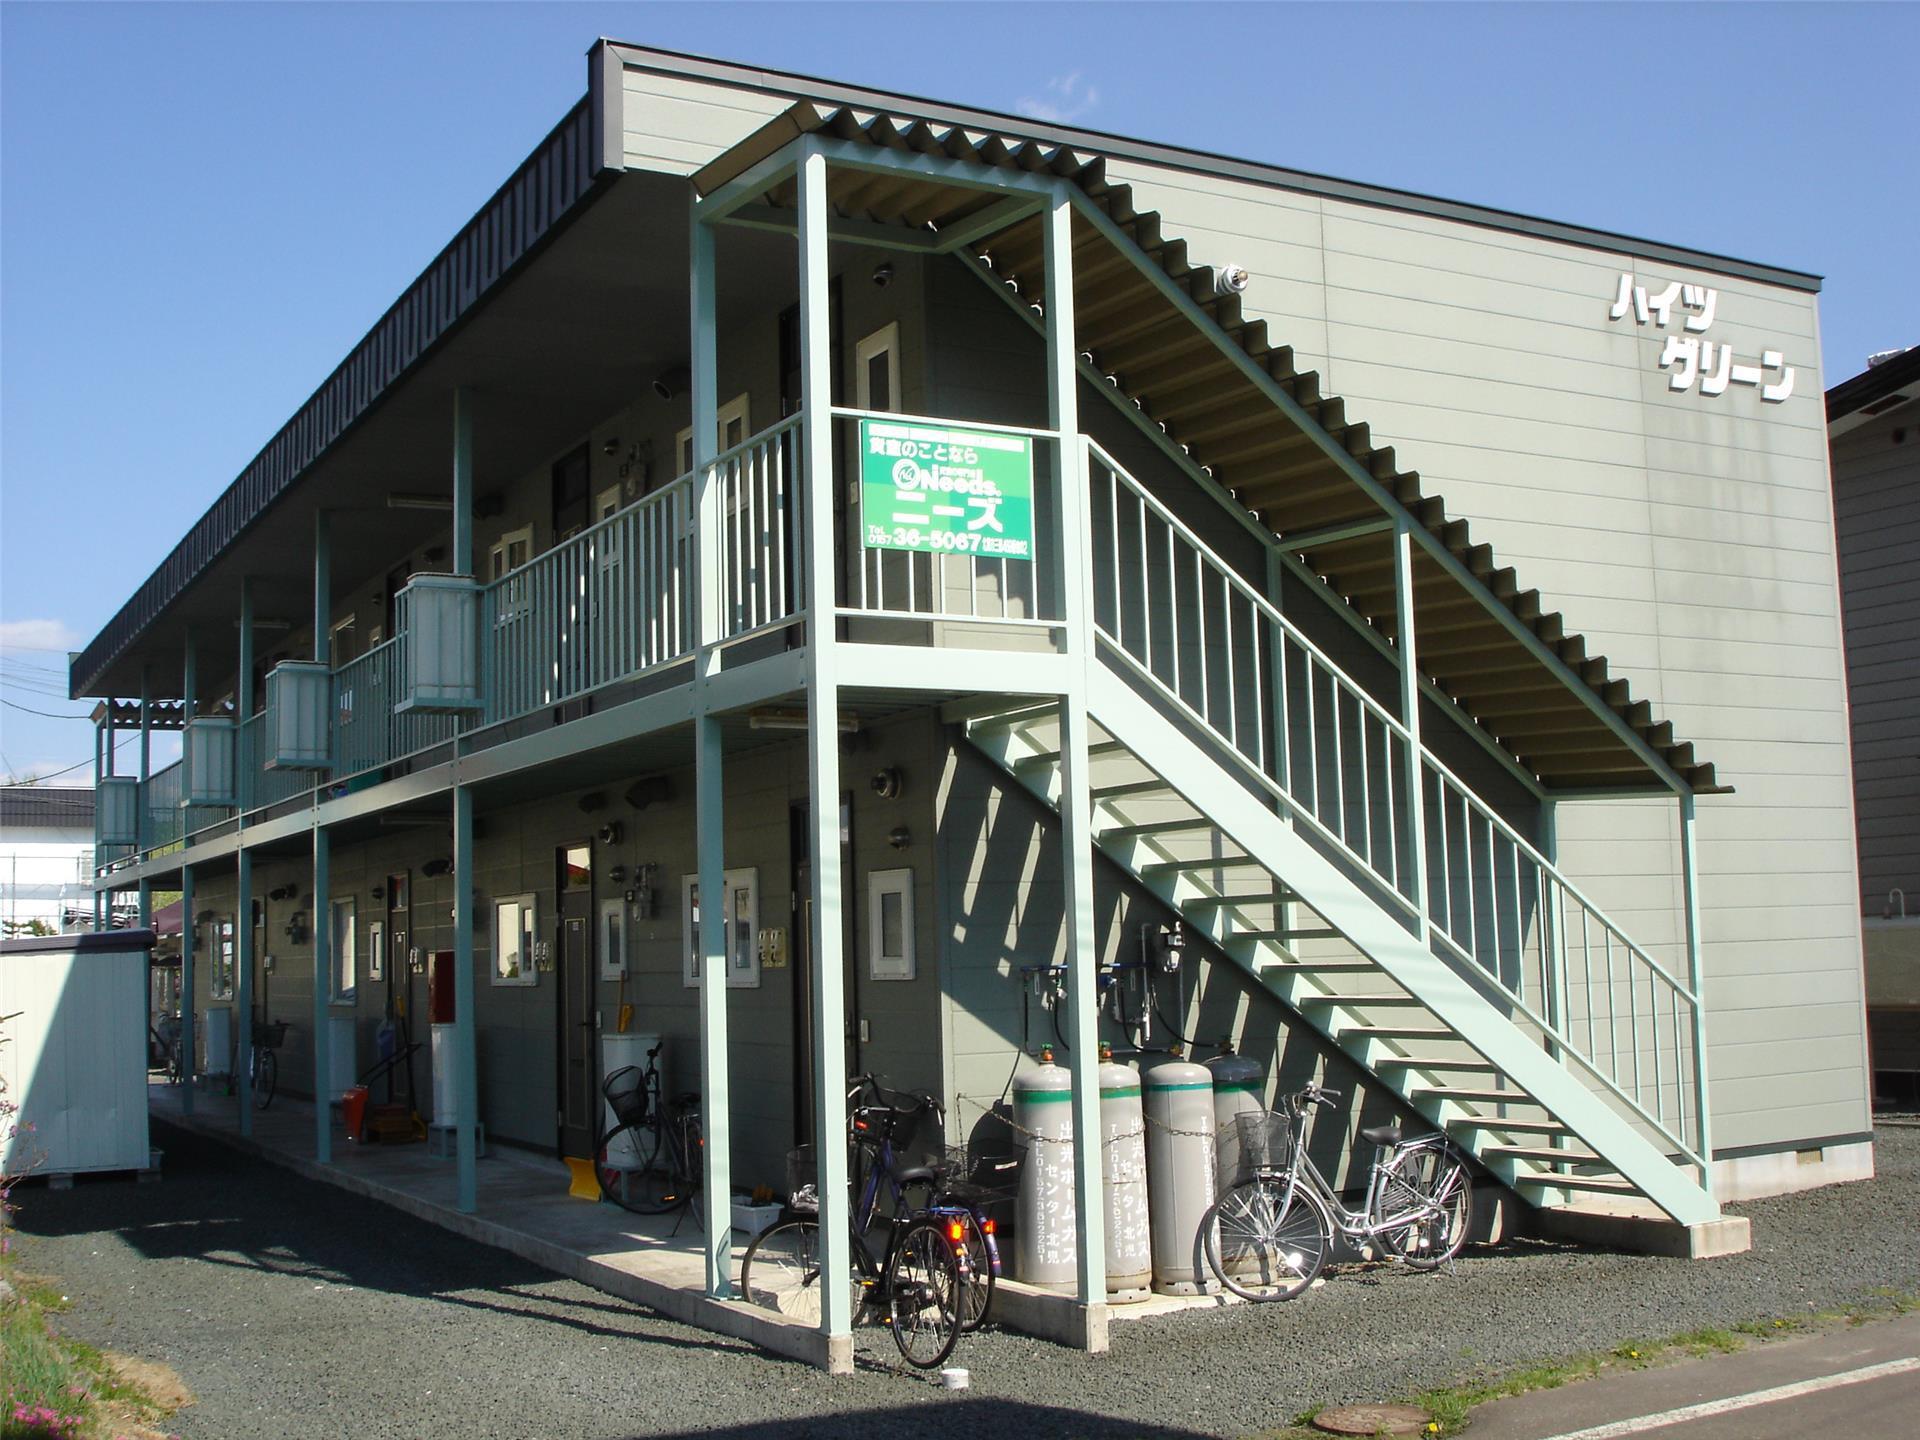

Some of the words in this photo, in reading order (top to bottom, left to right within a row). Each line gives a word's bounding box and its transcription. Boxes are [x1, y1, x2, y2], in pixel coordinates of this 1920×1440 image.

[1610, 273, 1717, 331] ハイツ
[1659, 335, 1794, 402] グリーン
[892, 491, 1003, 533] ニーズ
[893, 527, 981, 551] 36-5067
